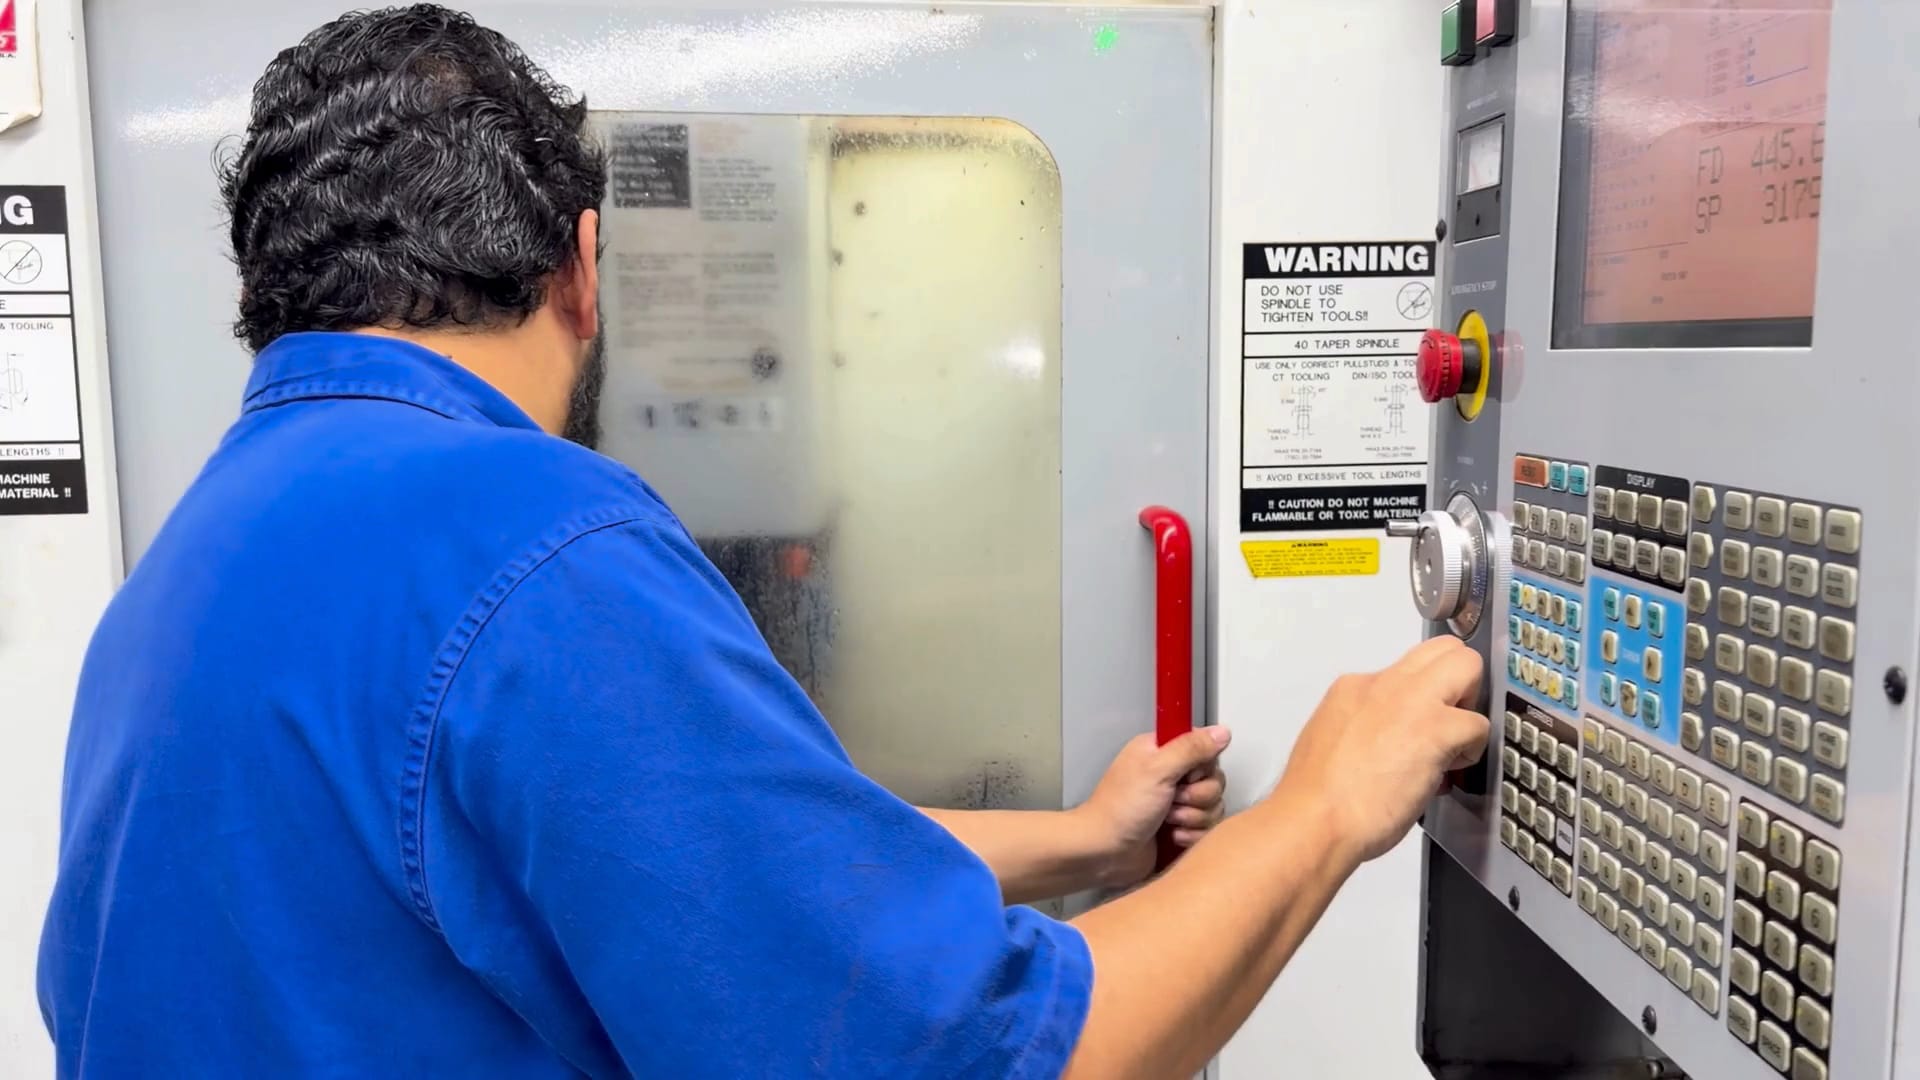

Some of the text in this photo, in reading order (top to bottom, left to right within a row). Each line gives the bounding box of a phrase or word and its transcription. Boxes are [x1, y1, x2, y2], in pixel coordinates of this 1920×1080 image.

[1697, 145, 1724, 187] FD
[0, 195, 34, 226] G
[1695, 194, 1722, 234] SP
[1264, 245, 1429, 272] WARNING
[1261, 284, 1343, 296] DO NOT USE
[1261, 298, 1336, 309] SPINDLE TO
[1261, 311, 1368, 323] TIGHTEN TOOLS!!
[10, 322, 54, 330] TOOLING
[1294, 339, 1400, 349] 40 TAPER SPINDLE
[1255, 361, 1271, 370] USE
[1275, 361, 1296, 369] ONLY
[1301, 360, 1339, 369] CORRECT
[1344, 360, 1389, 368] PULLSTUDS
[1272, 372, 1330, 382] CT TOOLING
[1393, 371, 1416, 379] TOOL
[0, 448, 50, 457] LENGTHS
[1266, 474, 1293, 482] AVOID
[1297, 472, 1346, 481] EXCESSIVE
[1352, 471, 1375, 480] TOOL
[1380, 470, 1422, 479] LENGTHS
[1626, 473, 1656, 489] DISPLAY
[1278, 498, 1324, 509] CAUTION
[1328, 498, 1343, 508] DO
[1347, 497, 1369, 507] NOT
[1374, 496, 1419, 506] MACHINE
[1252, 511, 1314, 522] FLAMMABLE
[1319, 511, 1334, 520] OR
[1339, 510, 1369, 520] TOXIC
